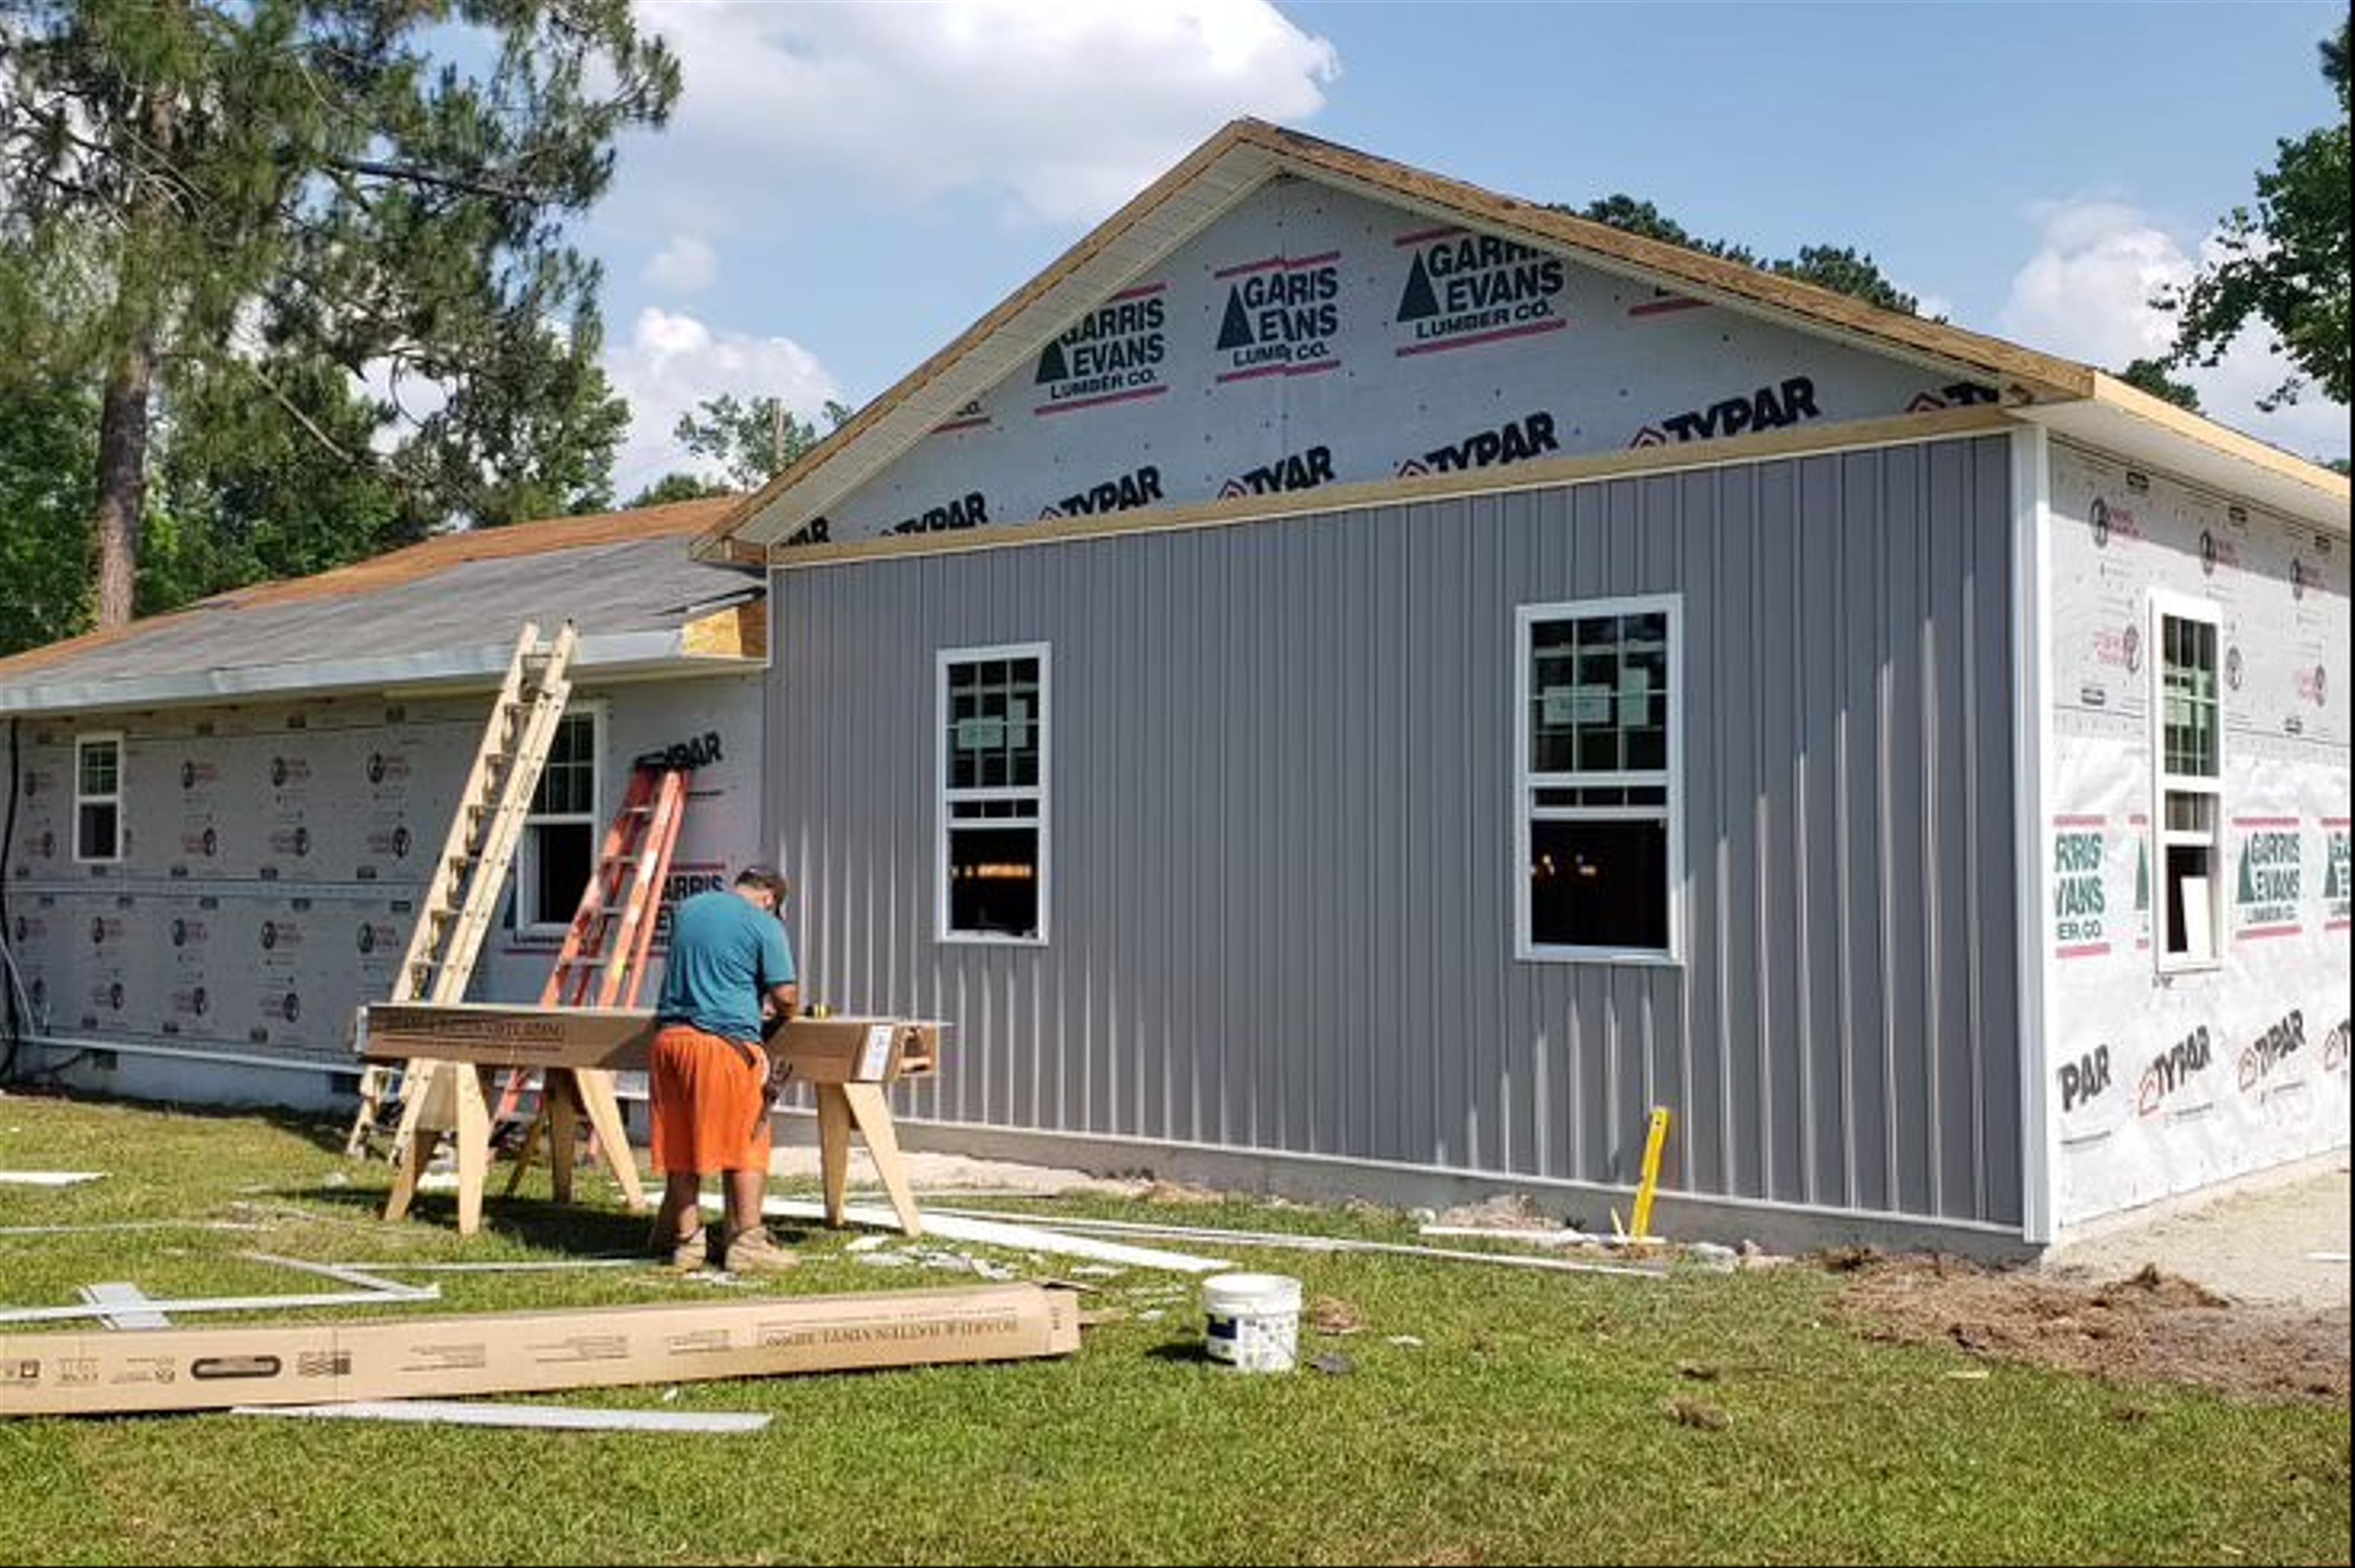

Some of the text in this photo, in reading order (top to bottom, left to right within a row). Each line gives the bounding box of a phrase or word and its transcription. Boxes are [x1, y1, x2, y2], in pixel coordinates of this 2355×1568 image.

[1447, 260, 1563, 313] EVANS
[1416, 308, 1509, 338] LUMBER
[1074, 334, 1165, 378] EVANS
[1051, 374, 1123, 400] LUMBER
[1662, 375, 1820, 443] TYPAR
[1425, 411, 1559, 472] TYPAR
[1061, 465, 1164, 517] TYPAR
